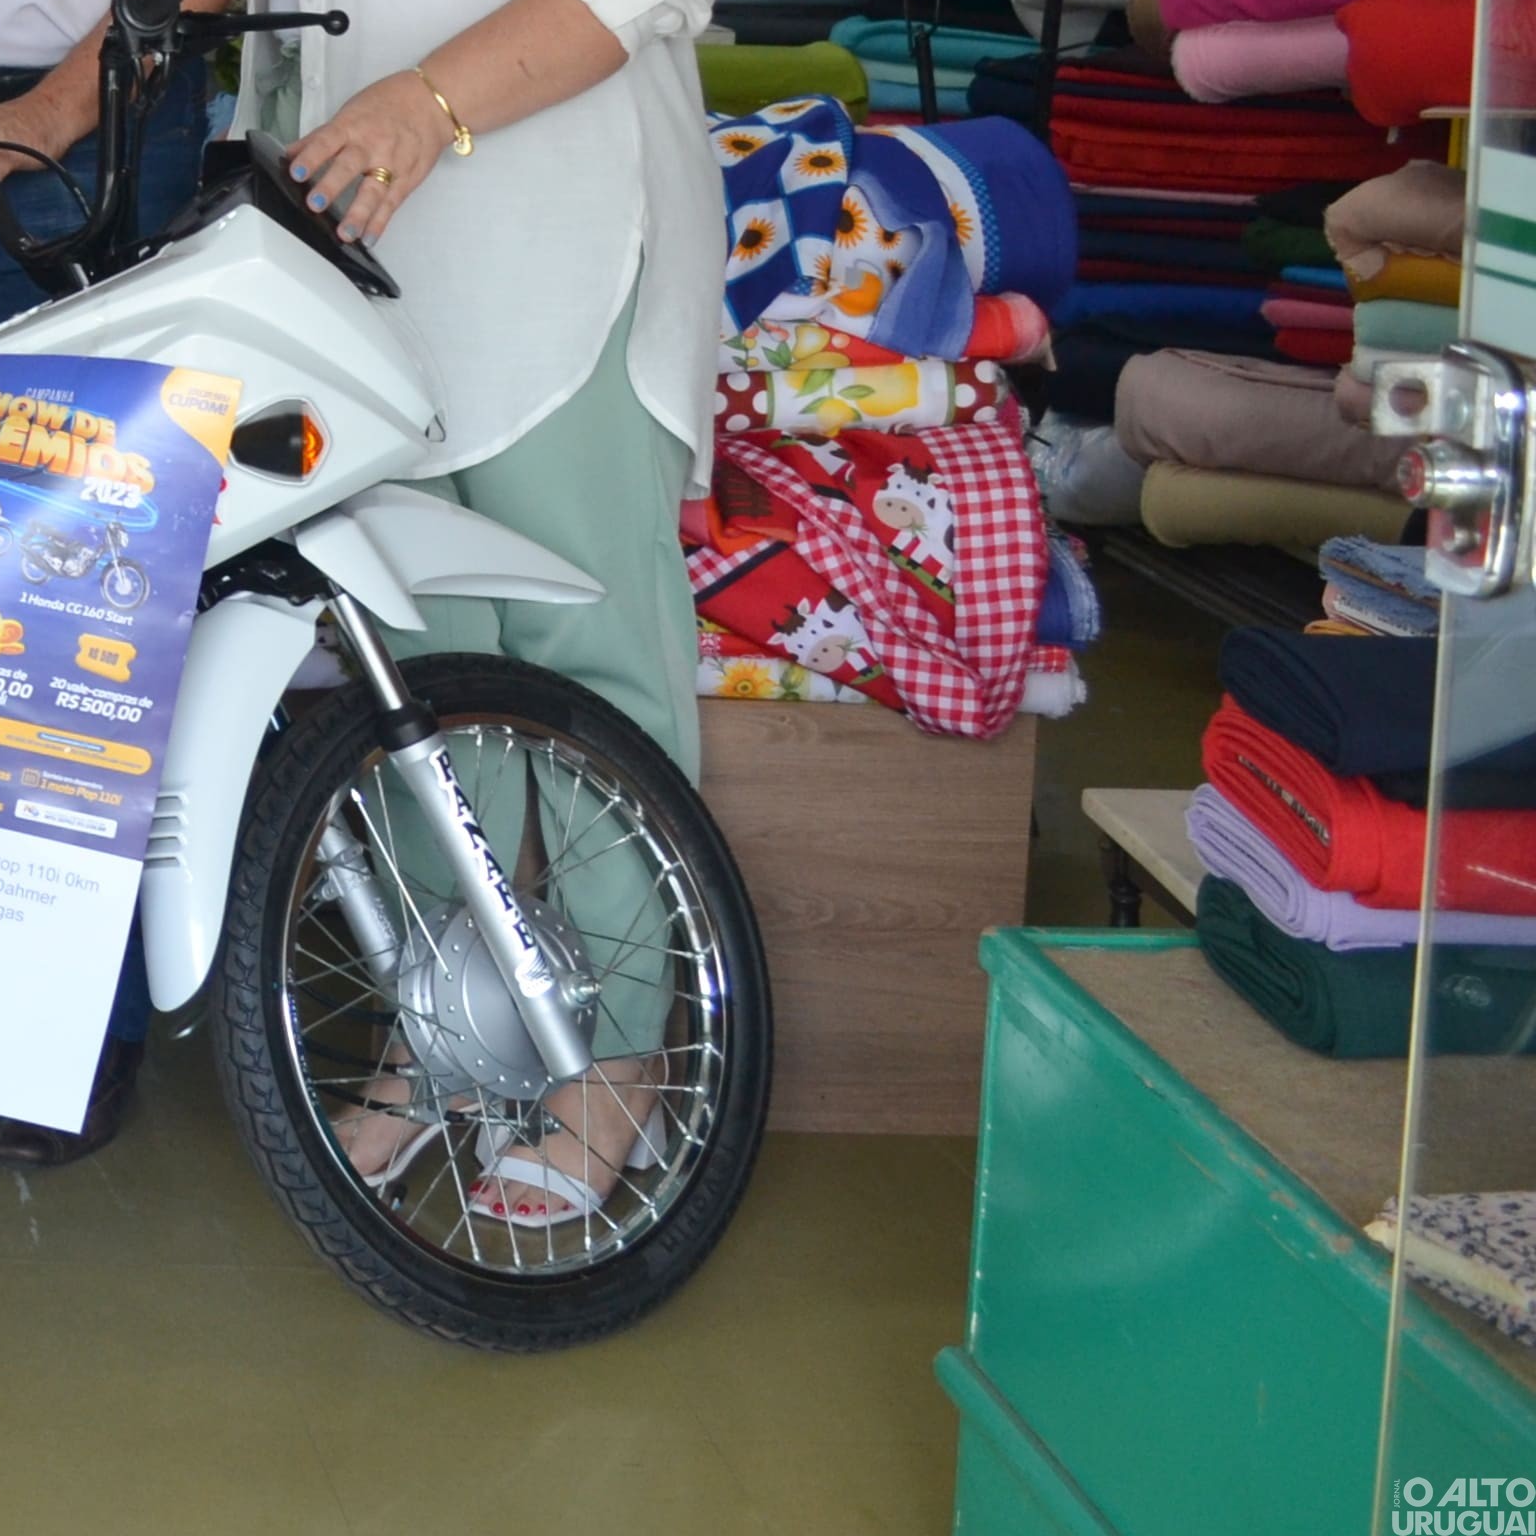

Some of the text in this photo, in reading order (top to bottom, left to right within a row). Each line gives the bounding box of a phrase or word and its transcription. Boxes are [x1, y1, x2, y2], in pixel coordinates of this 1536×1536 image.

[71, 409, 117, 445] DE
[80, 477, 144, 508] 2023
[19, 591, 135, 626] 1 Honda CG 160 Start
[12, 668, 28, 681] de
[49, 676, 154, 710] 20 vale-compras de
[79, 696, 143, 723] 500,00
[49, 781, 76, 795] moto
[27, 863, 61, 884] 110i
[65, 872, 100, 894] 0km
